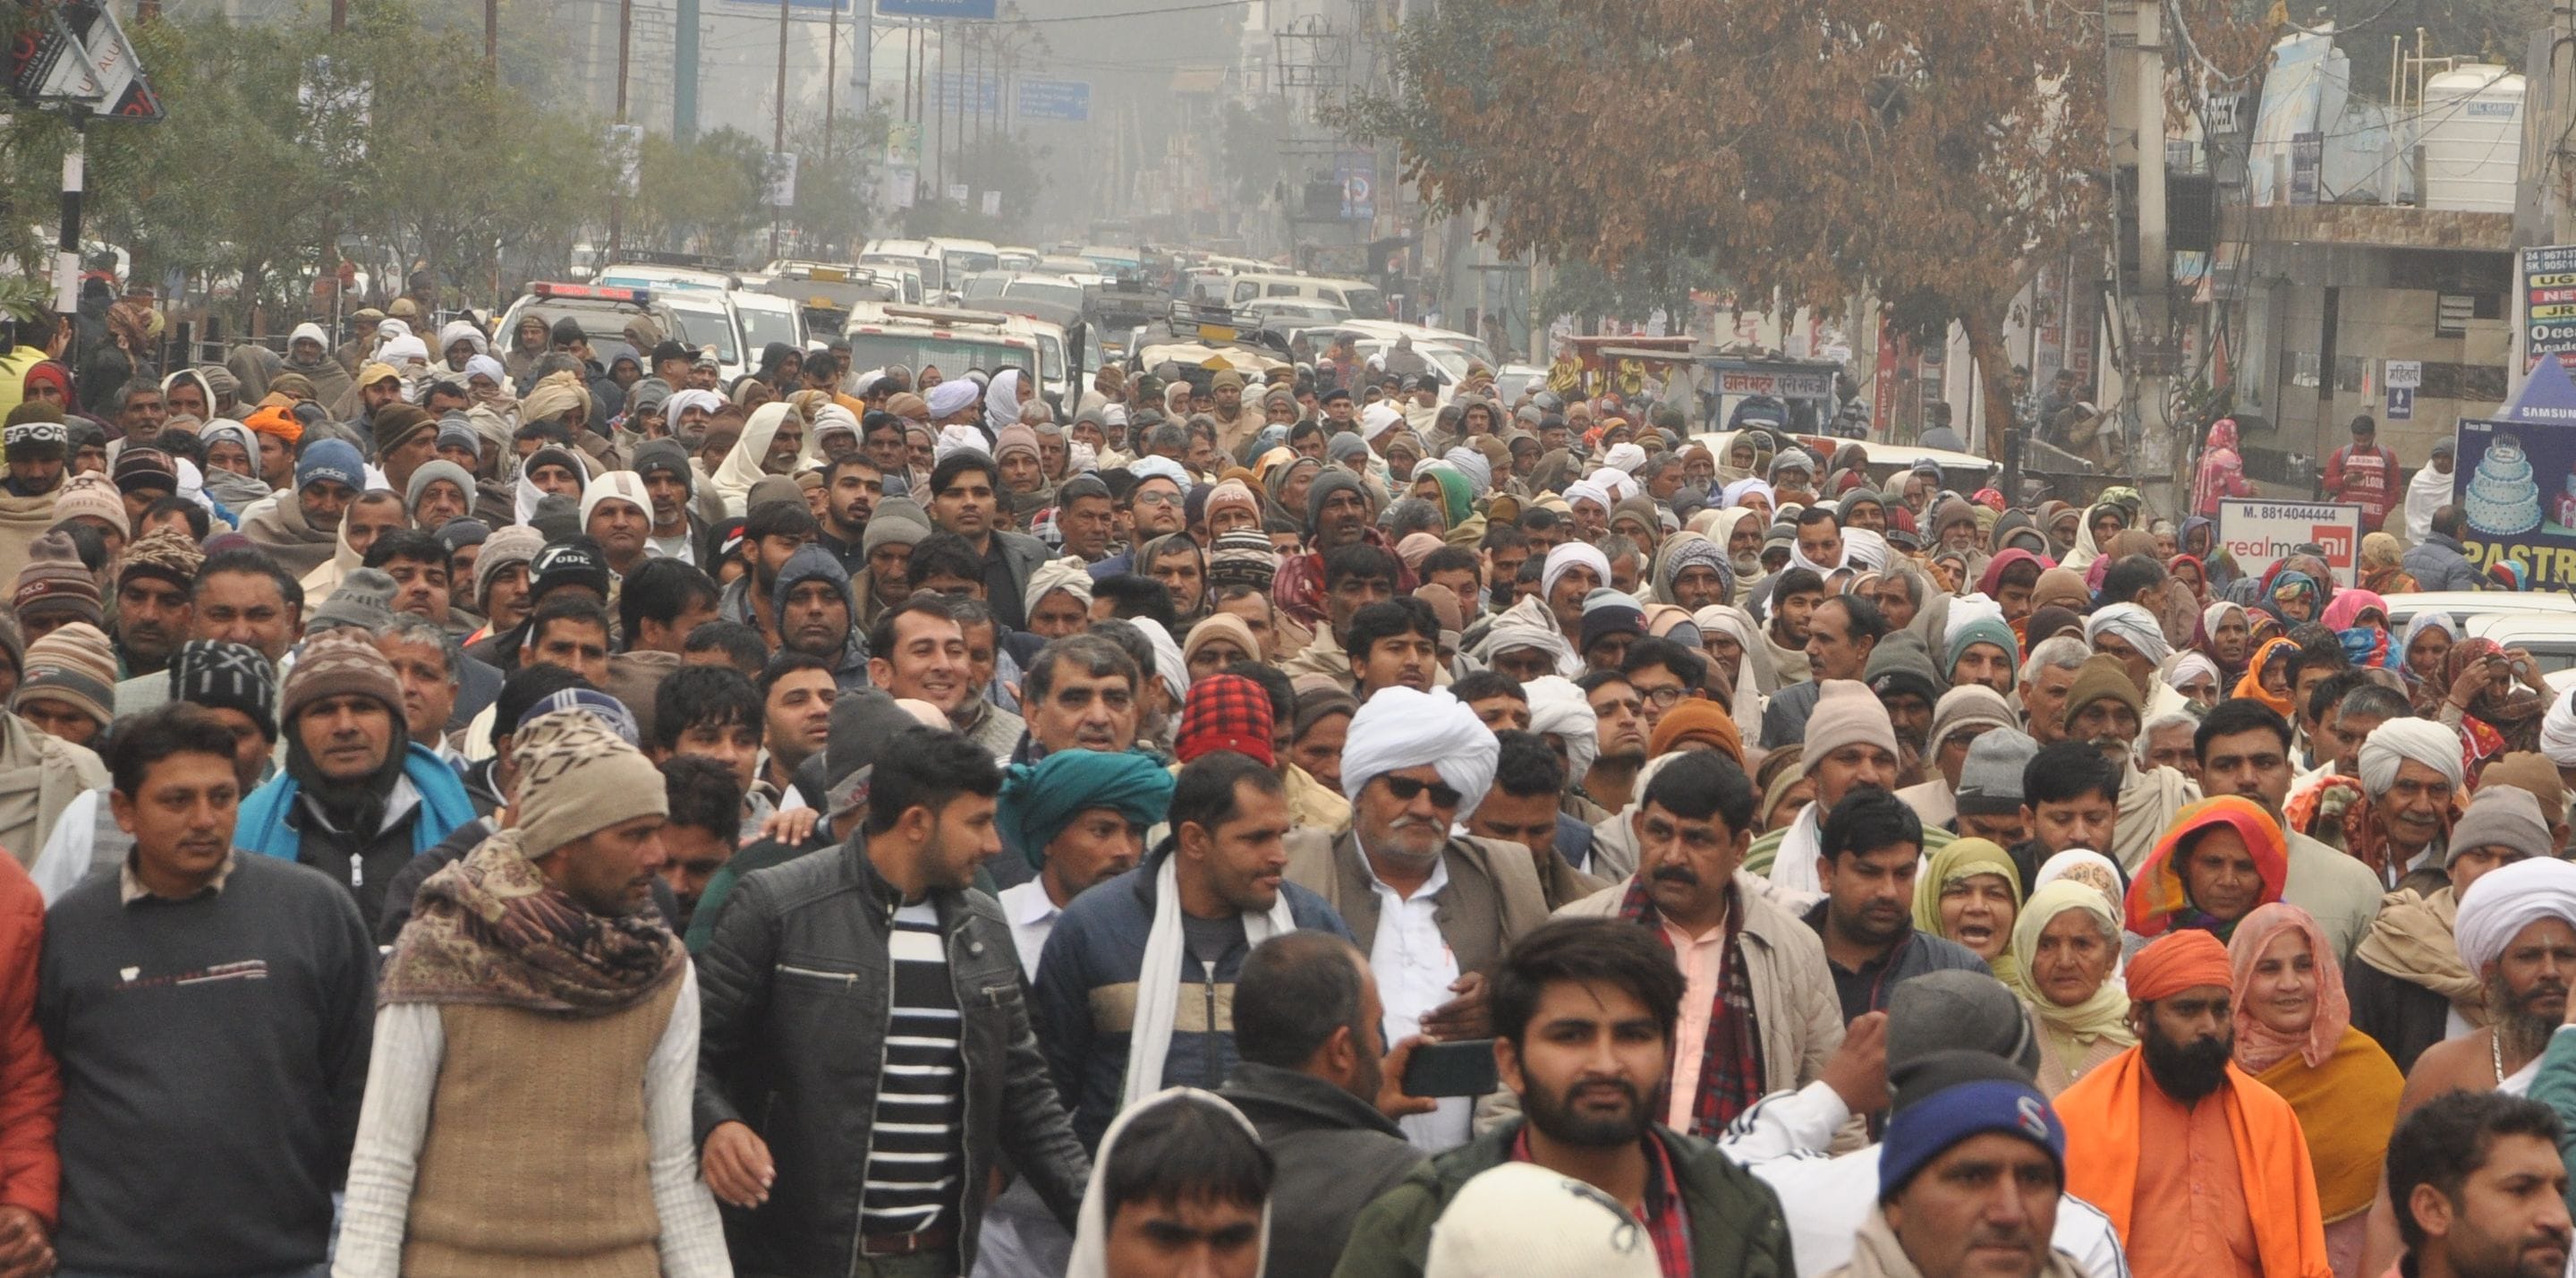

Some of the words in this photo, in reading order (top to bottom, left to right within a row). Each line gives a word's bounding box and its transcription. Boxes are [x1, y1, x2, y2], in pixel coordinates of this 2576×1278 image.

[2544, 289, 2576, 302] NE
[2530, 325, 2576, 341] Oce
[304, 467, 347, 481] adidas
[2261, 507, 2336, 521] 8814044444
